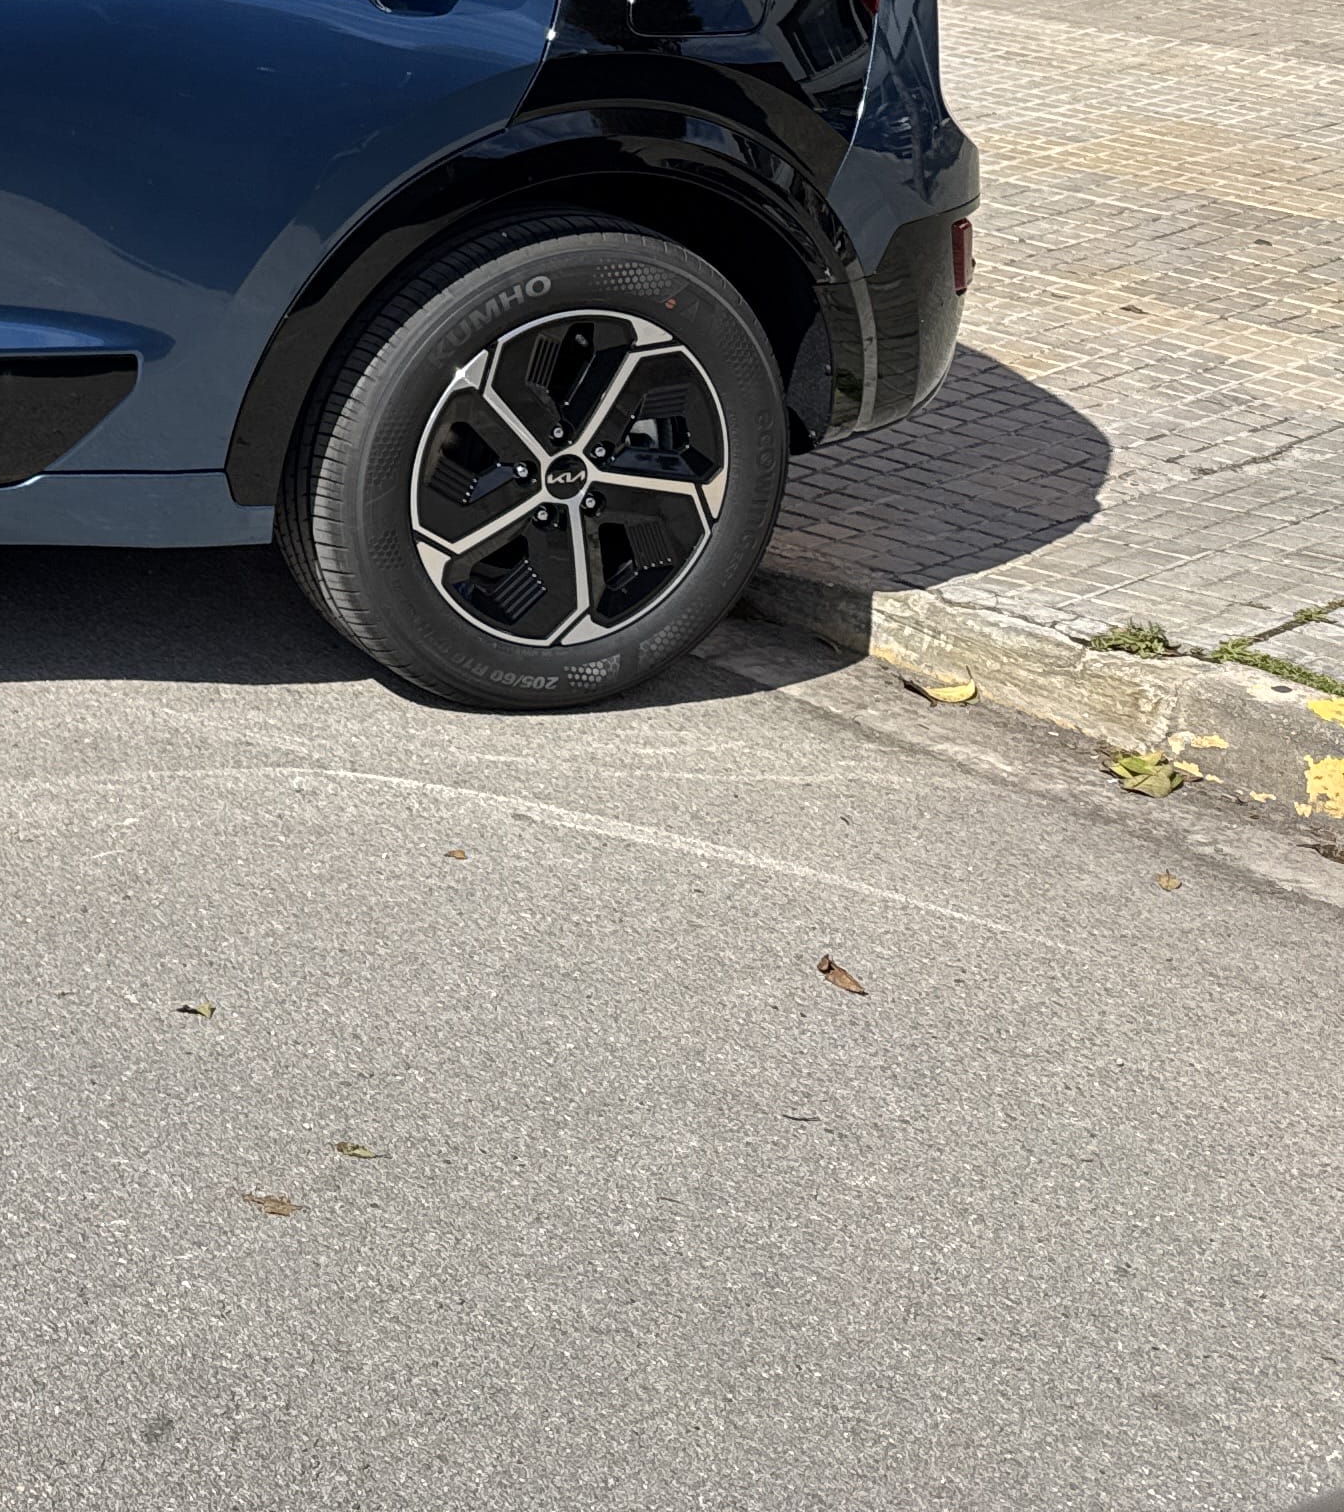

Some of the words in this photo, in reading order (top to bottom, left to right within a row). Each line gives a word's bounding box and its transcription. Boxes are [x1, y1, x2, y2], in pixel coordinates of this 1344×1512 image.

[428, 275, 552, 366] KUMHO
[547, 470, 586, 484] KIA
[490, 669, 560, 690] 205/60
